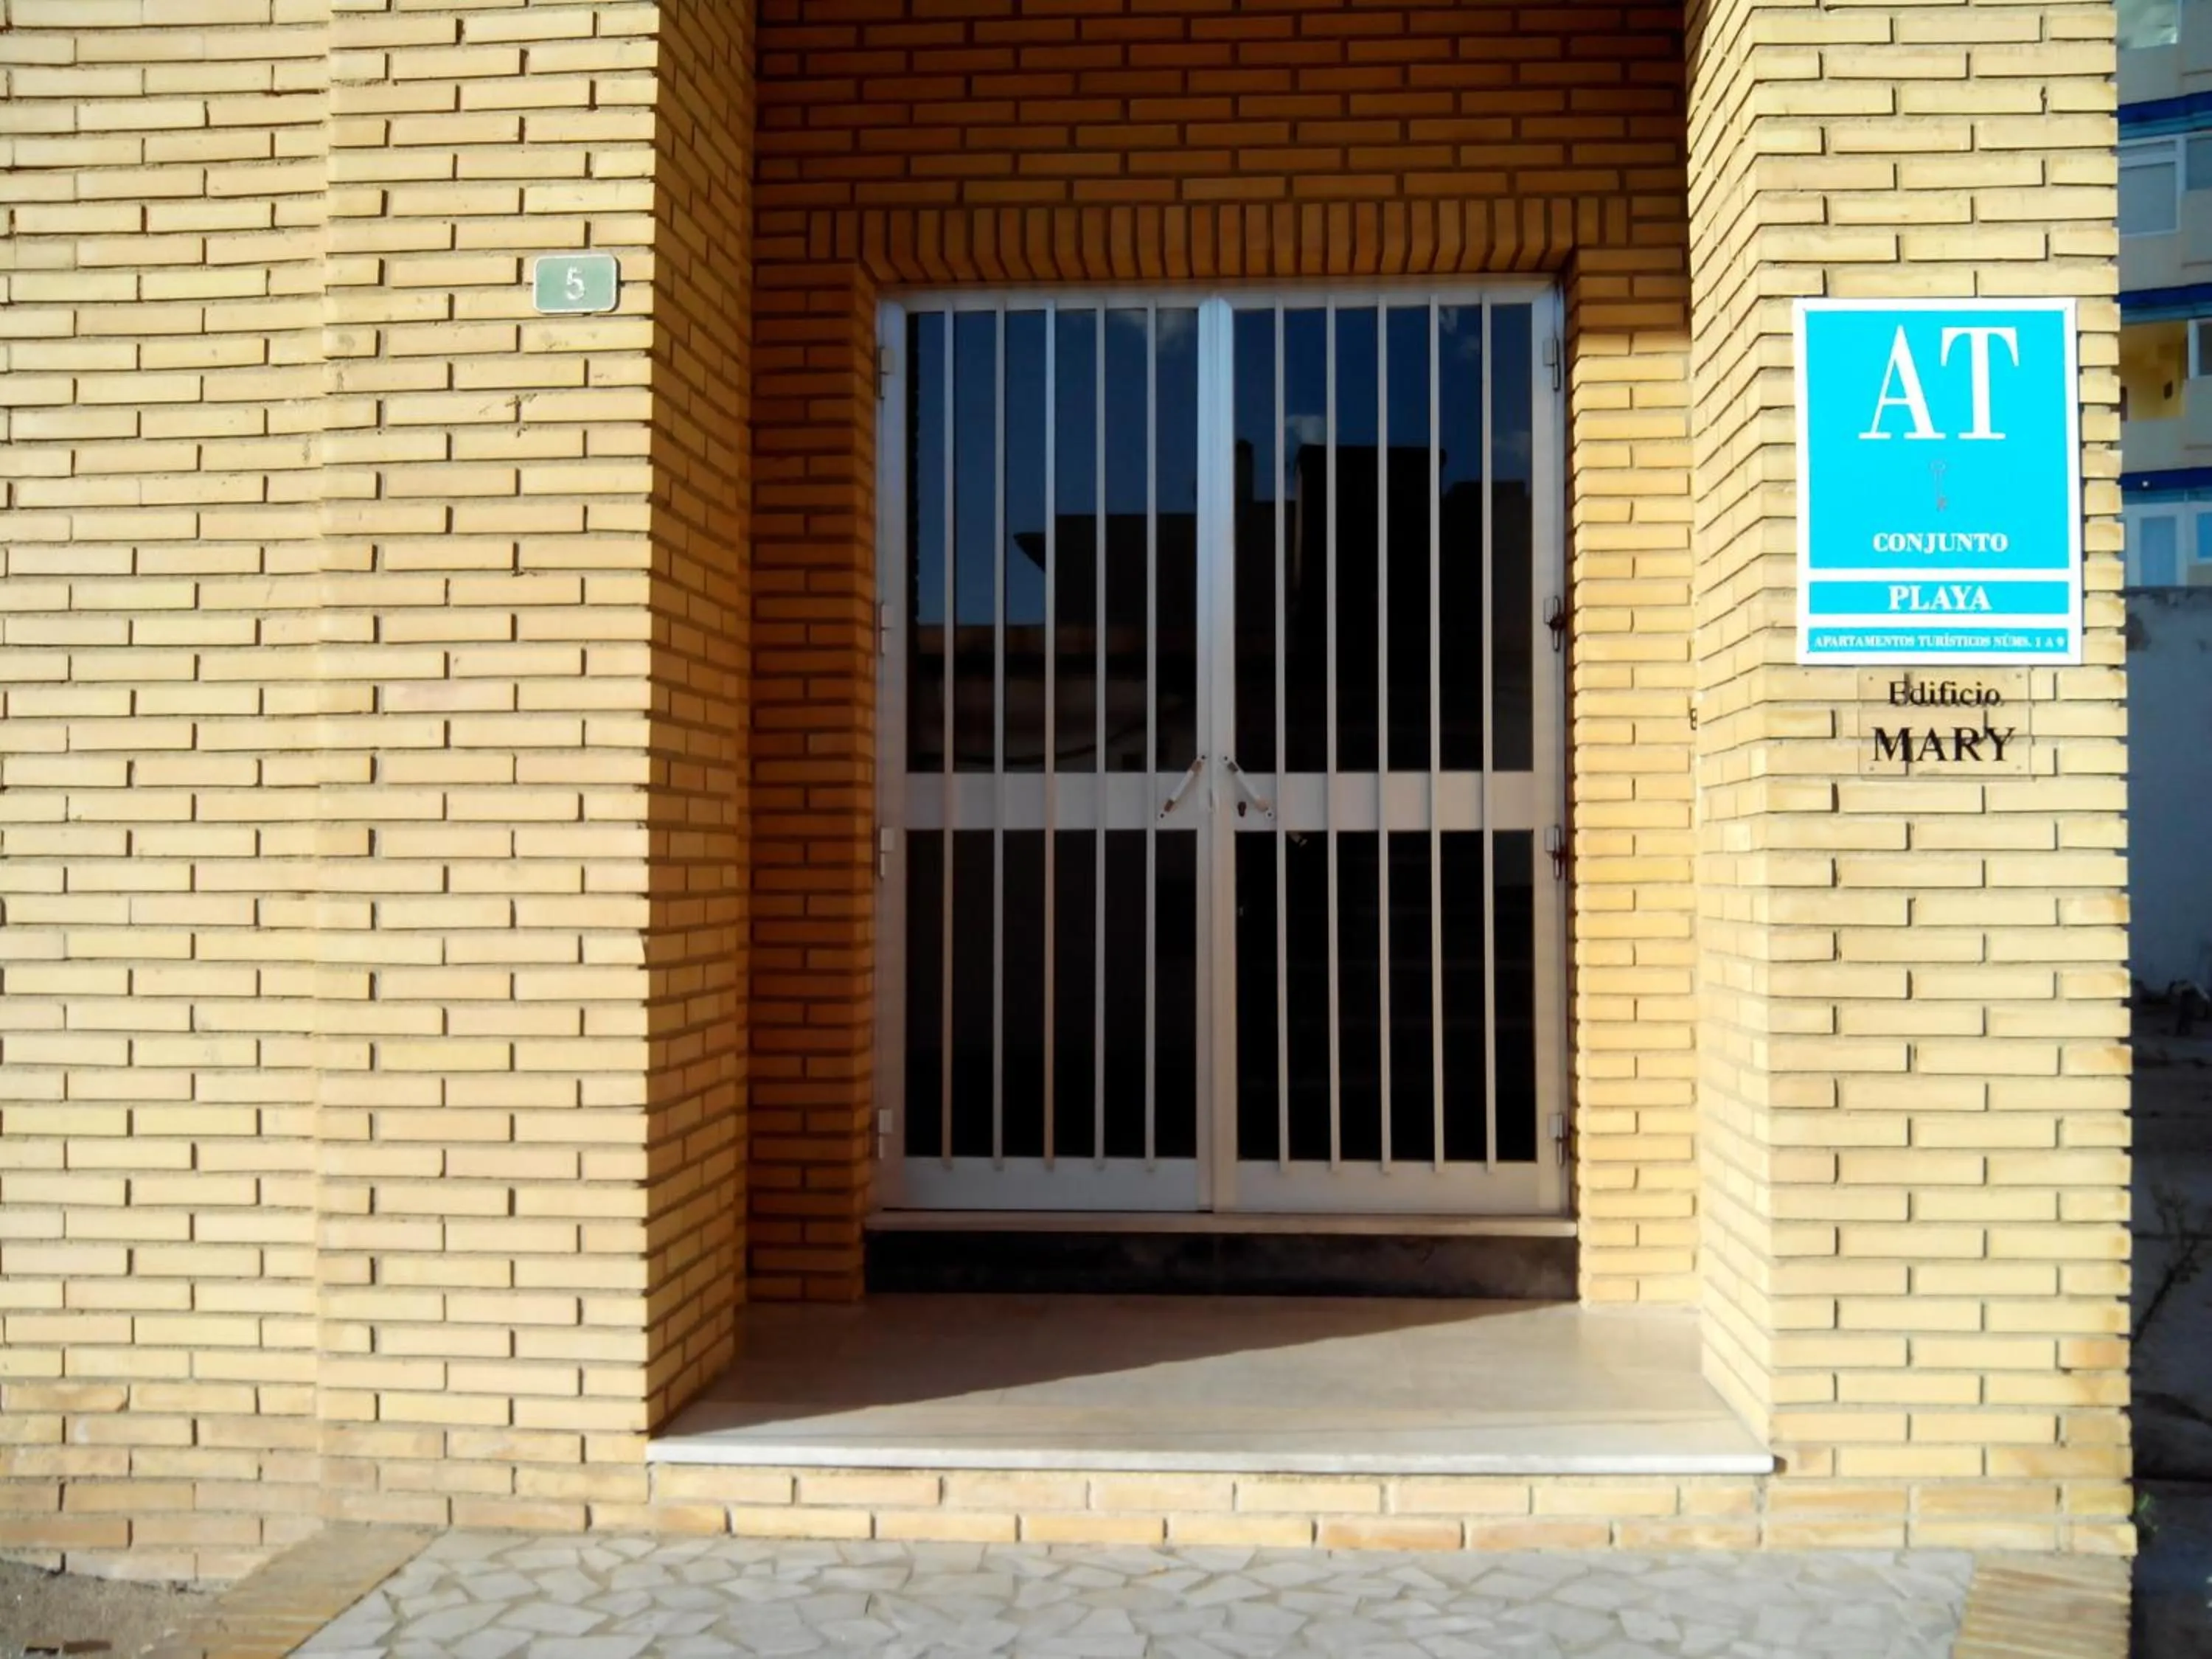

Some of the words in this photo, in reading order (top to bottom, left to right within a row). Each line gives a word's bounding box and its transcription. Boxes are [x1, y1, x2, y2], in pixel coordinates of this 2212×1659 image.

[565, 266, 585, 300] 5
[1858, 324, 2020, 439] AT
[1872, 532, 2009, 554] CONJUNTO
[1888, 585, 1993, 611] PLAYA
[1815, 635, 1915, 647] APARTAMENTOS
[1889, 681, 2001, 706] Edificio
[1872, 726, 2017, 762] MARY
